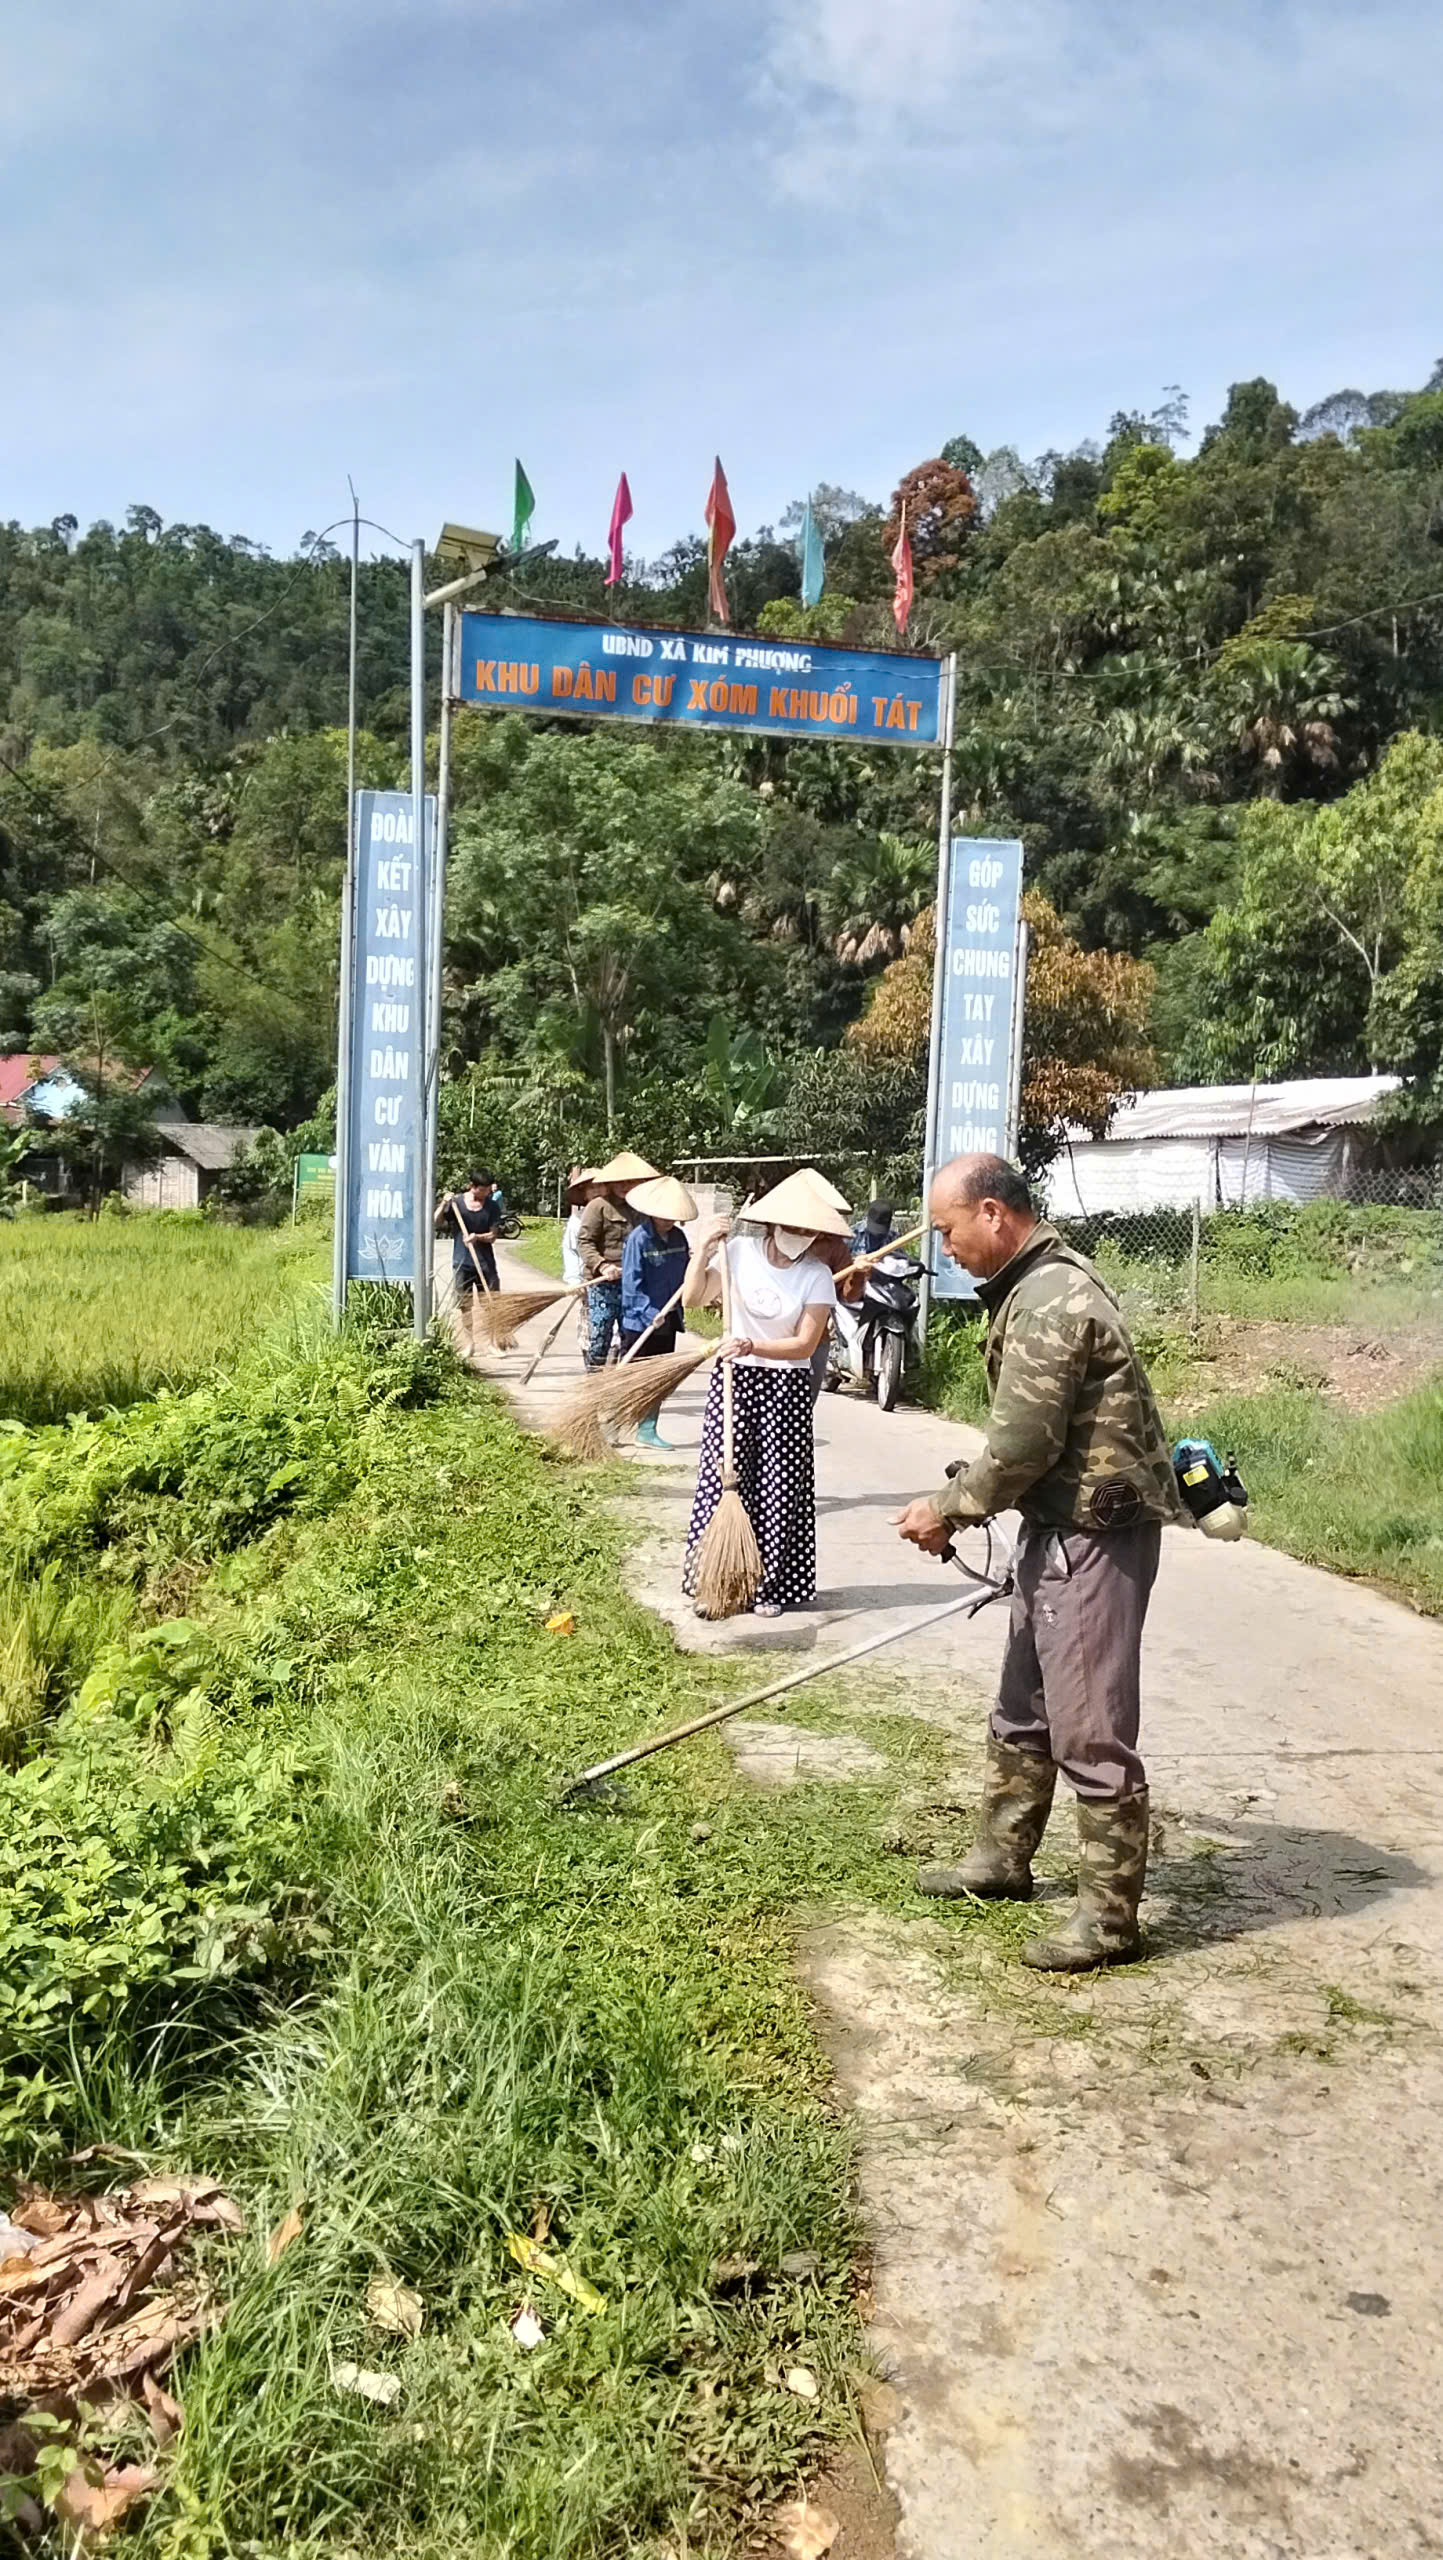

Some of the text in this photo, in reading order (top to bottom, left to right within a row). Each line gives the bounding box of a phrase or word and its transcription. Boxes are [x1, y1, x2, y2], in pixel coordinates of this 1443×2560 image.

[602, 634, 653, 657] UBND
[692, 644, 729, 665] KIM
[735, 647, 812, 675] PHƯỢNG
[476, 659, 922, 731] KHU DÂN CƯ XÓM KHUỔI TÁT
[377, 854, 412, 891] KẾT
[968, 854, 1003, 888] GÓP
[375, 904, 412, 939] XÂY
[966, 898, 1000, 933] SỨC
[366, 954, 414, 991] DỰNG
[953, 948, 1010, 978] CHUNG
[371, 1003, 409, 1033] KHU
[963, 993, 995, 1022] TAY
[370, 1045, 408, 1079] DÂN
[960, 1033, 995, 1065] XÂY
[374, 1095, 403, 1125] CƯ
[951, 1080, 1000, 1114] DỰNG
[950, 1120, 998, 1153] NÔNG
[368, 1138, 405, 1172] VĂN
[366, 1184, 404, 1218] HÓA
